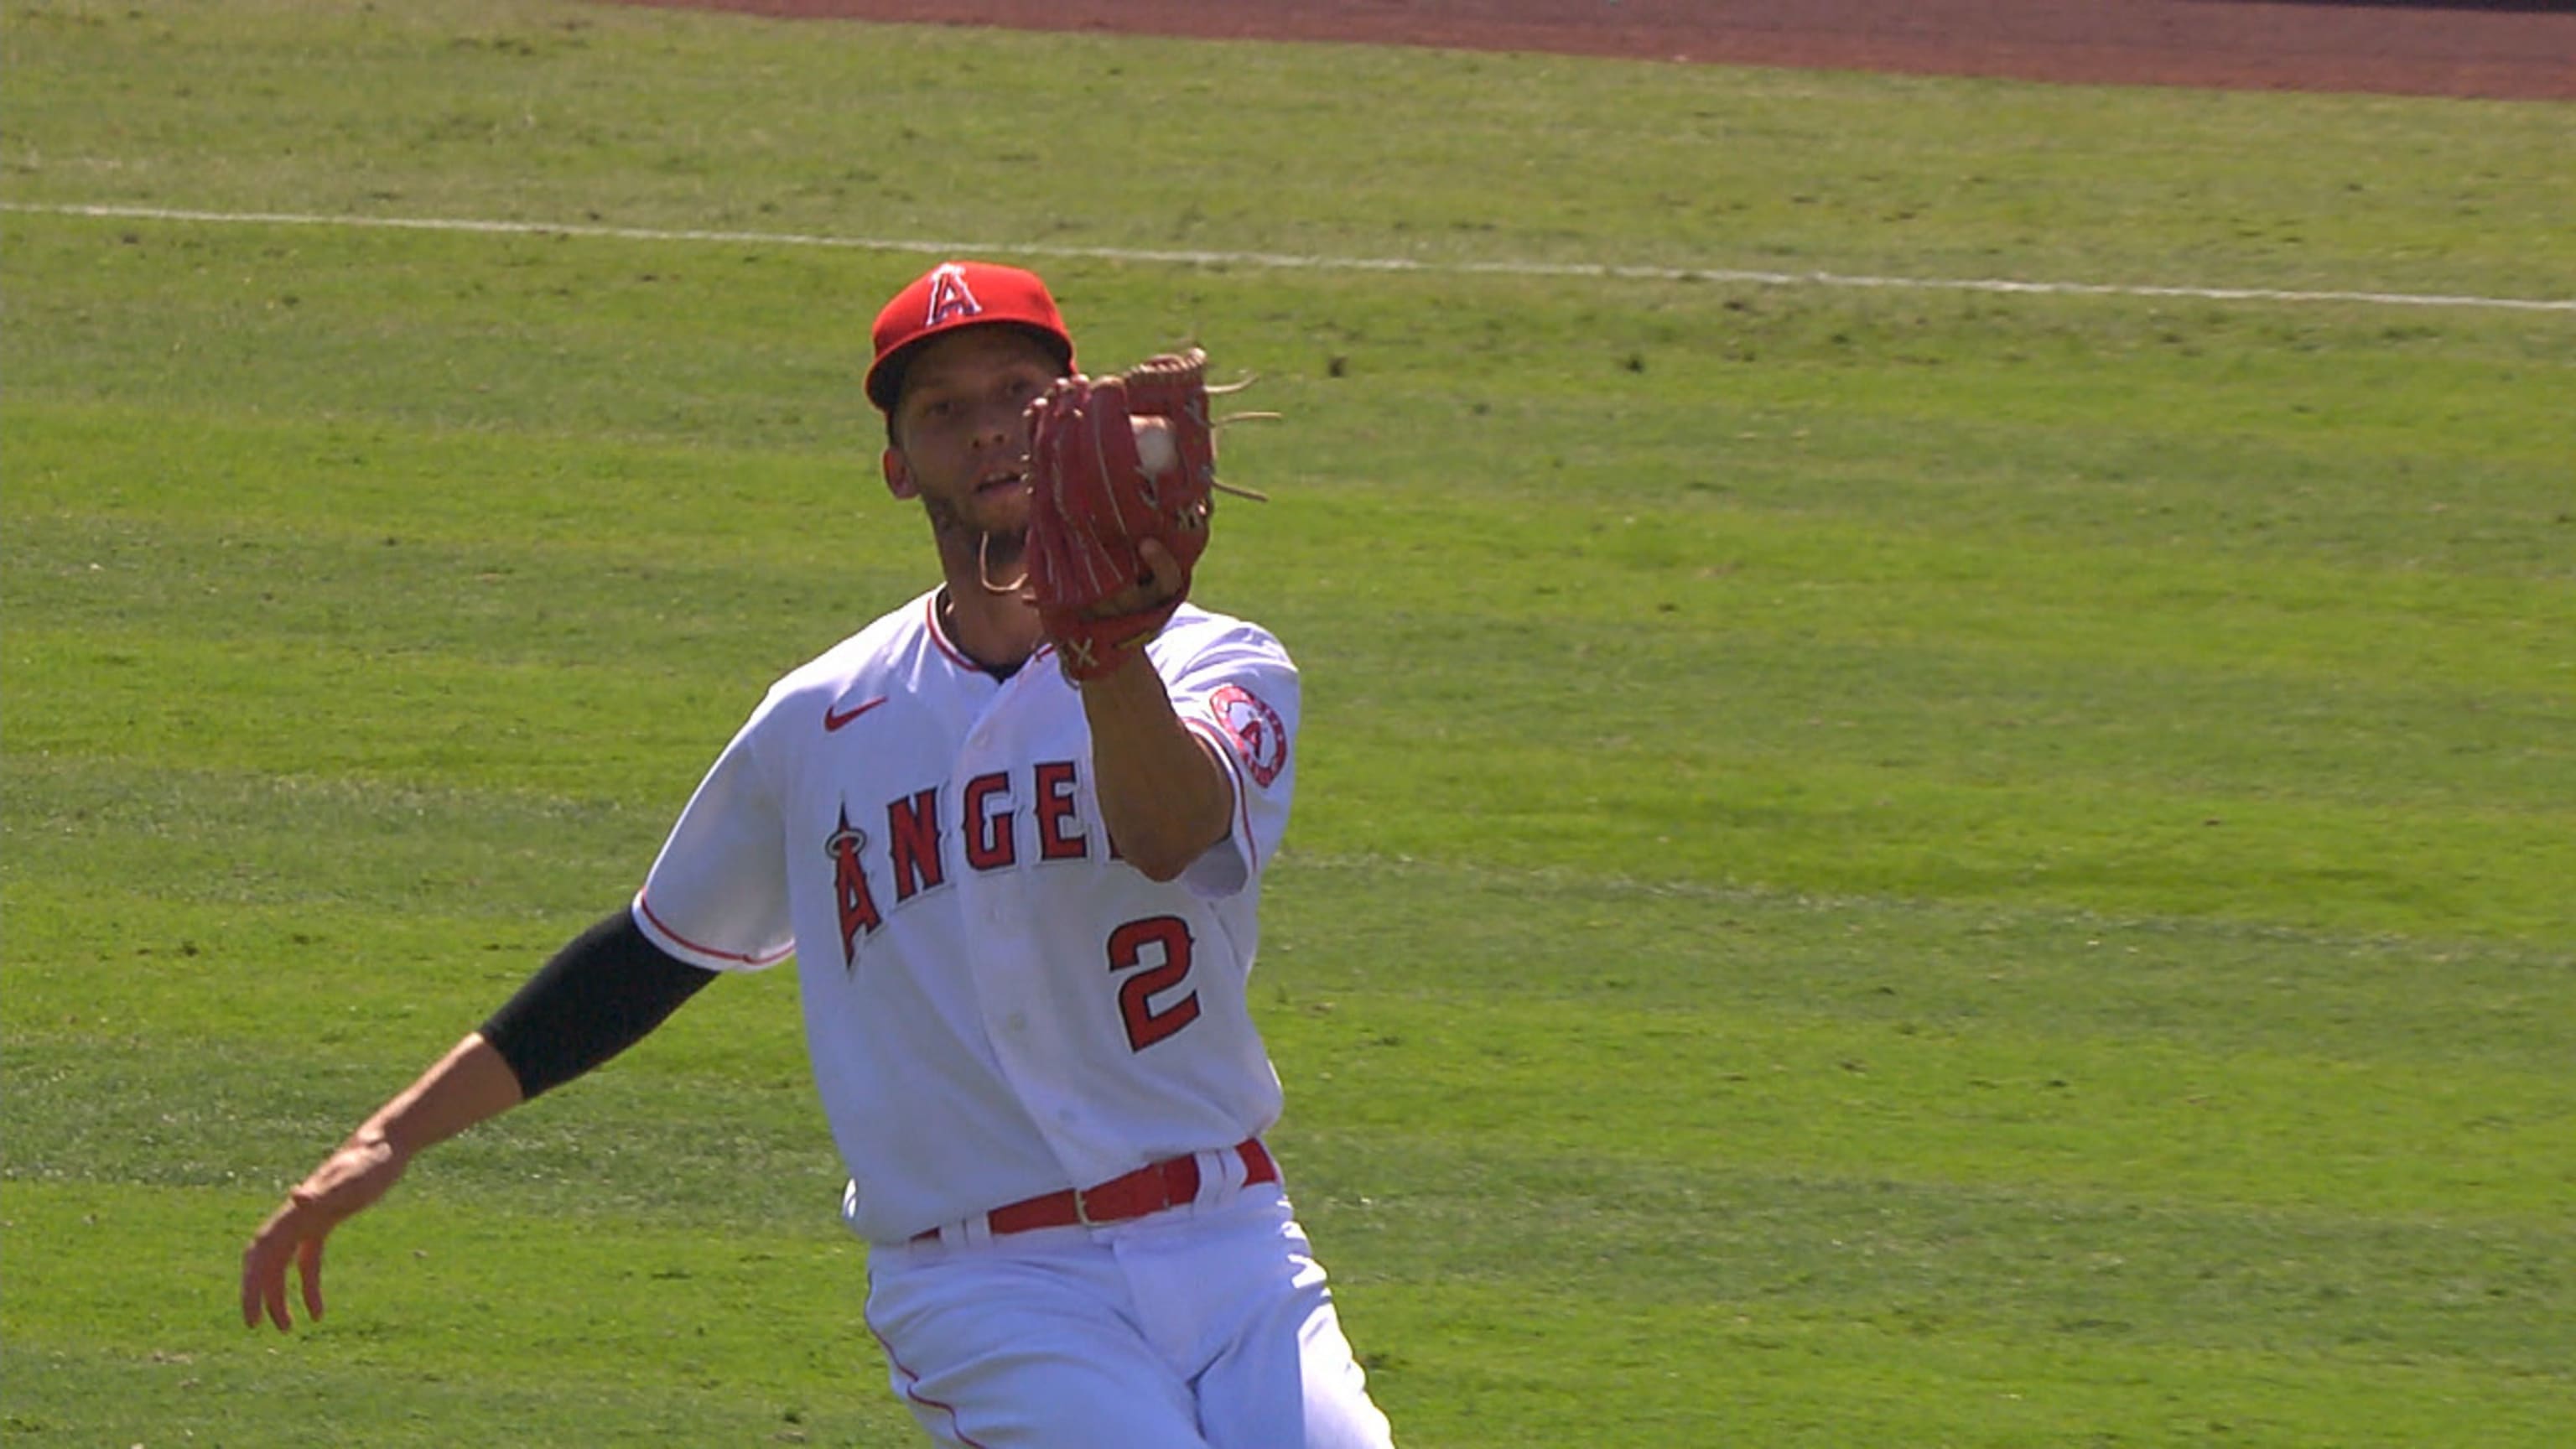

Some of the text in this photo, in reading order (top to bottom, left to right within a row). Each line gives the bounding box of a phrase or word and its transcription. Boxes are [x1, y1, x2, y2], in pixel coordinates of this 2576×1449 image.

[926, 262, 983, 327] A
[825, 760, 1125, 971] ANGE
[1106, 914, 1201, 1054] 2
